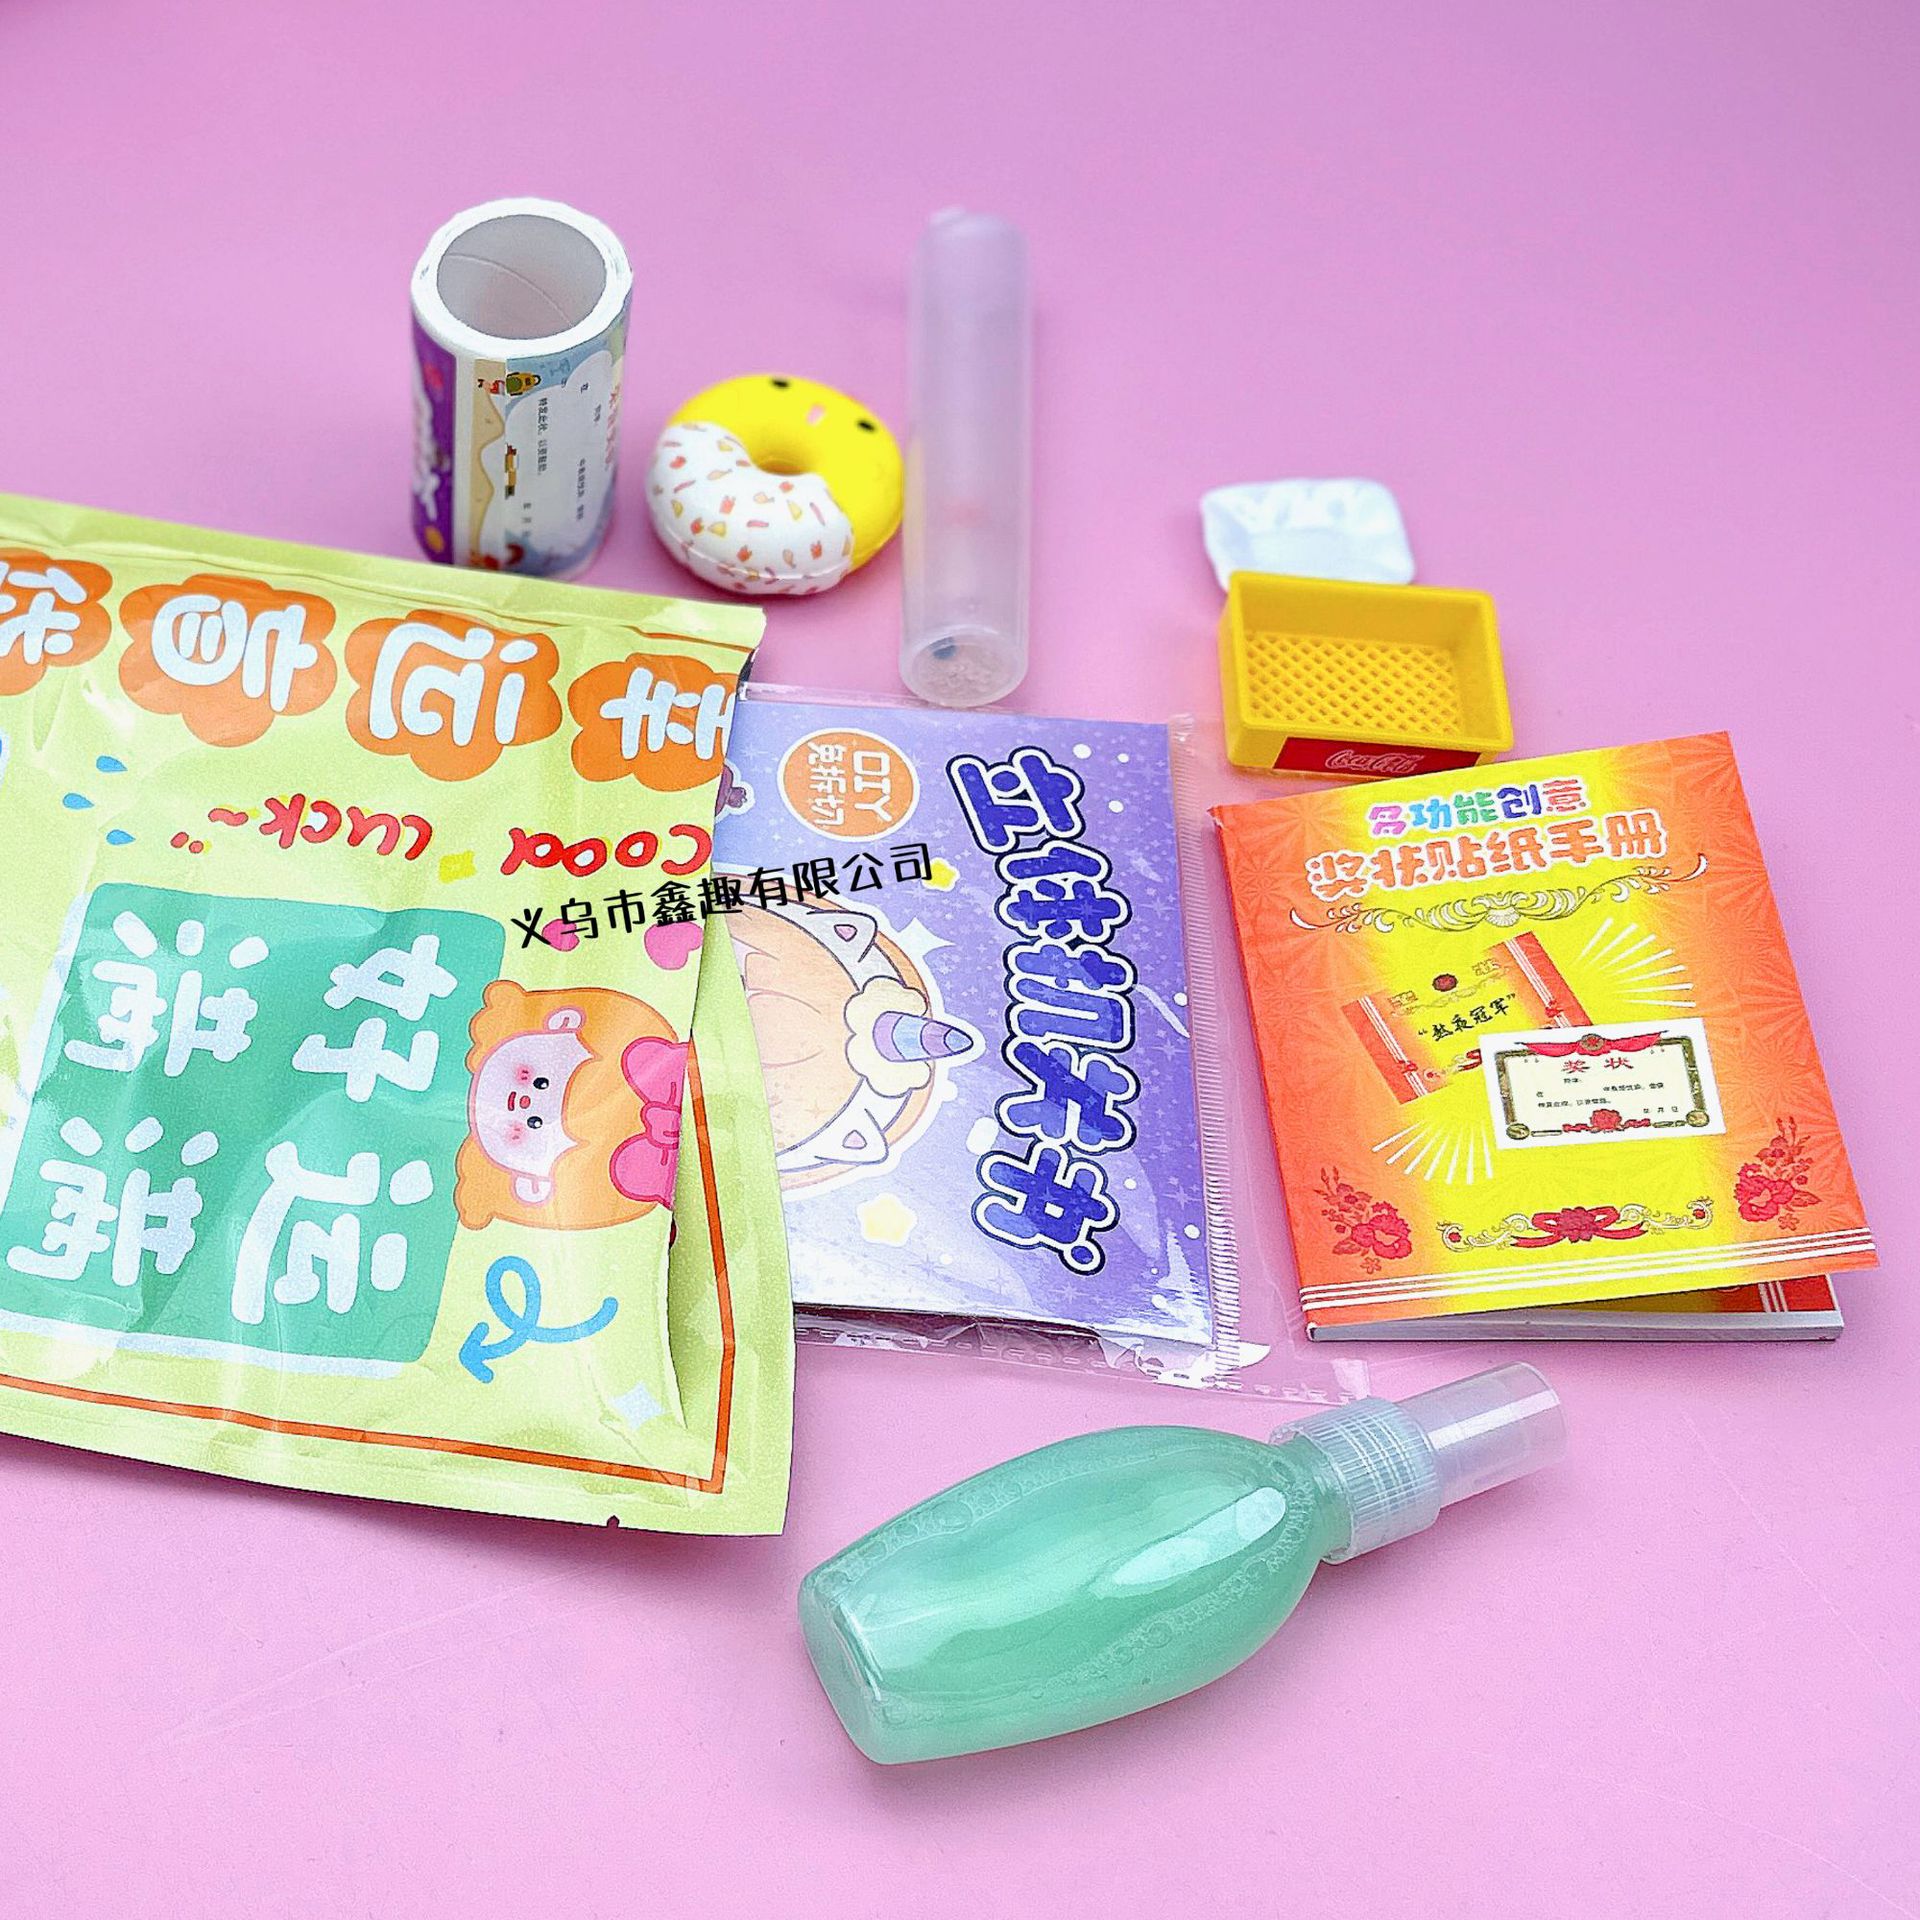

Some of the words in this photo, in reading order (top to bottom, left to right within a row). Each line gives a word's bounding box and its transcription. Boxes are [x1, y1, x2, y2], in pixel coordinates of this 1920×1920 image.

[853, 750, 892, 822] DIY
[1308, 811, 1667, 898] 奖状贴纸手册
[1368, 779, 1587, 837] 多功能创意
[6, 911, 270, 1287] 满满
[947, 746, 1139, 1274] 立体机关书
[231, 934, 459, 1325] 好运
